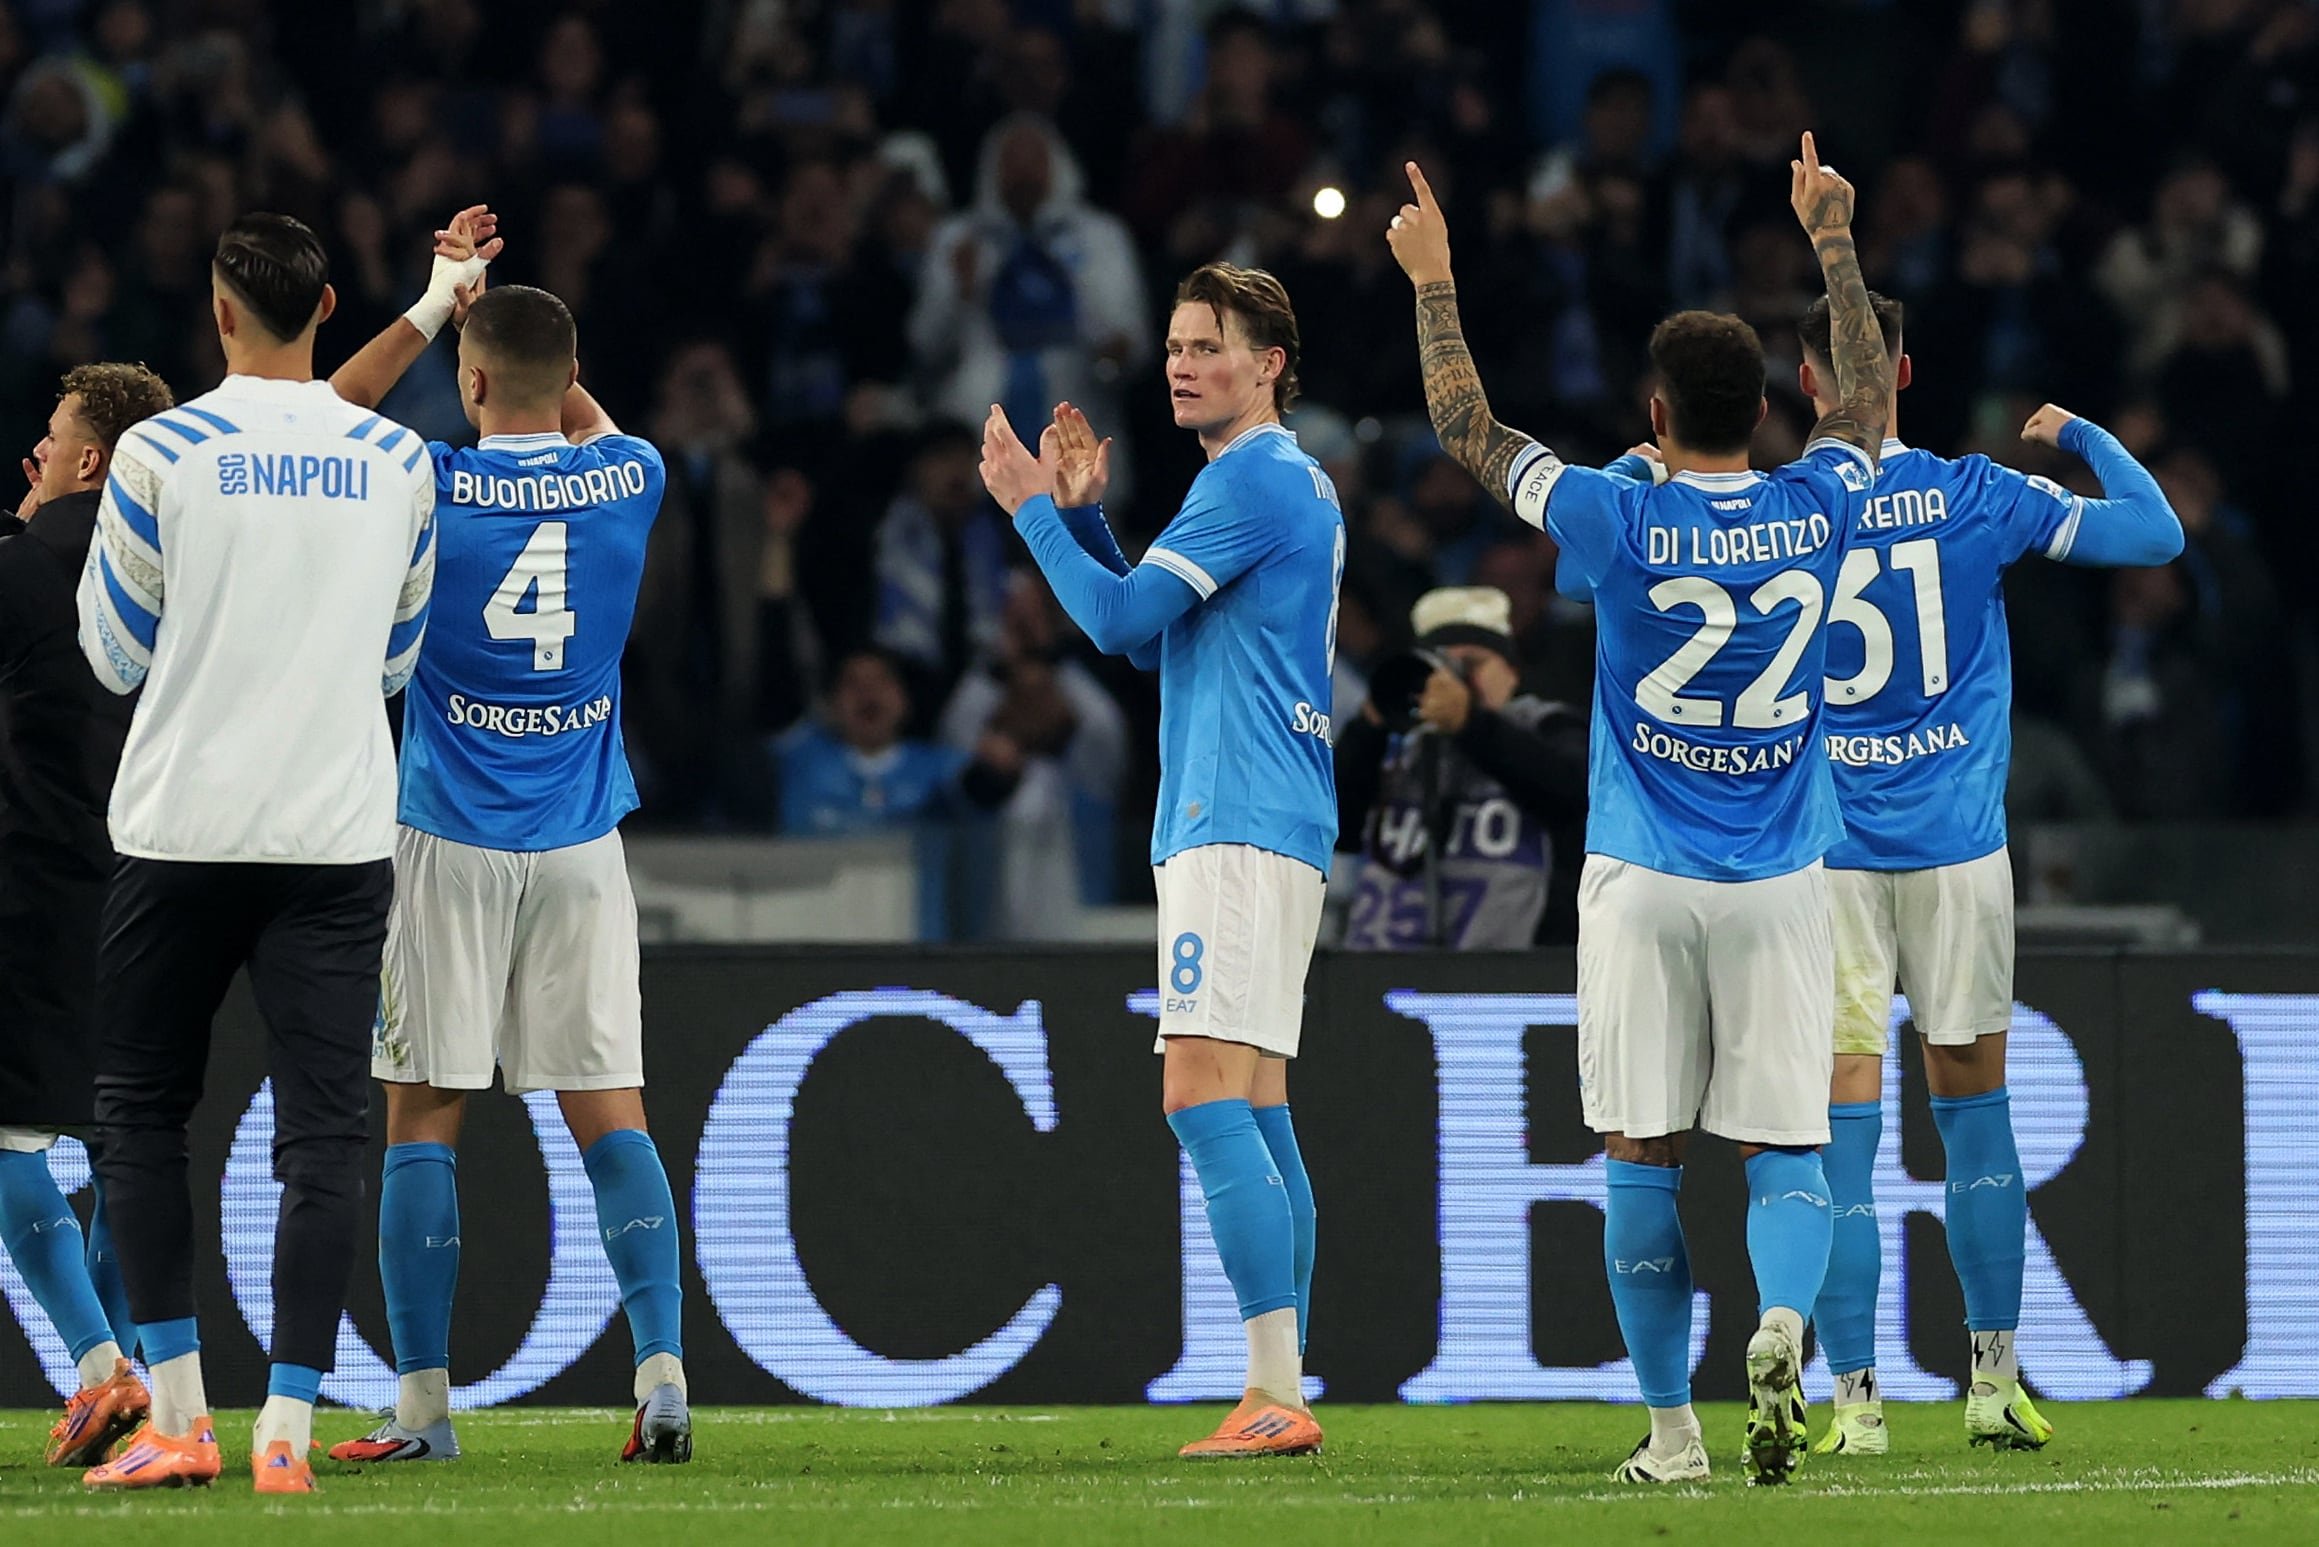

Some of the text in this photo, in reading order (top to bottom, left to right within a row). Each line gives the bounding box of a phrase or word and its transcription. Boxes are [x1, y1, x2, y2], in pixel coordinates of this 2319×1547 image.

[217, 453, 368, 500] SSC NAPOLI
[453, 460, 646, 510] BUONGIORNO
[1649, 513, 1830, 565] DI LORENZO
[482, 521, 576, 671] 4
[1634, 568, 1824, 729] 22
[448, 694, 612, 738] SORGESANA
[1170, 932, 1204, 995] 8
[1166, 998, 1198, 1014] EA7
[1952, 1173, 2014, 1195] EA7
[605, 1215, 664, 1241] EA7
[1615, 1256, 1674, 1275] EA7
